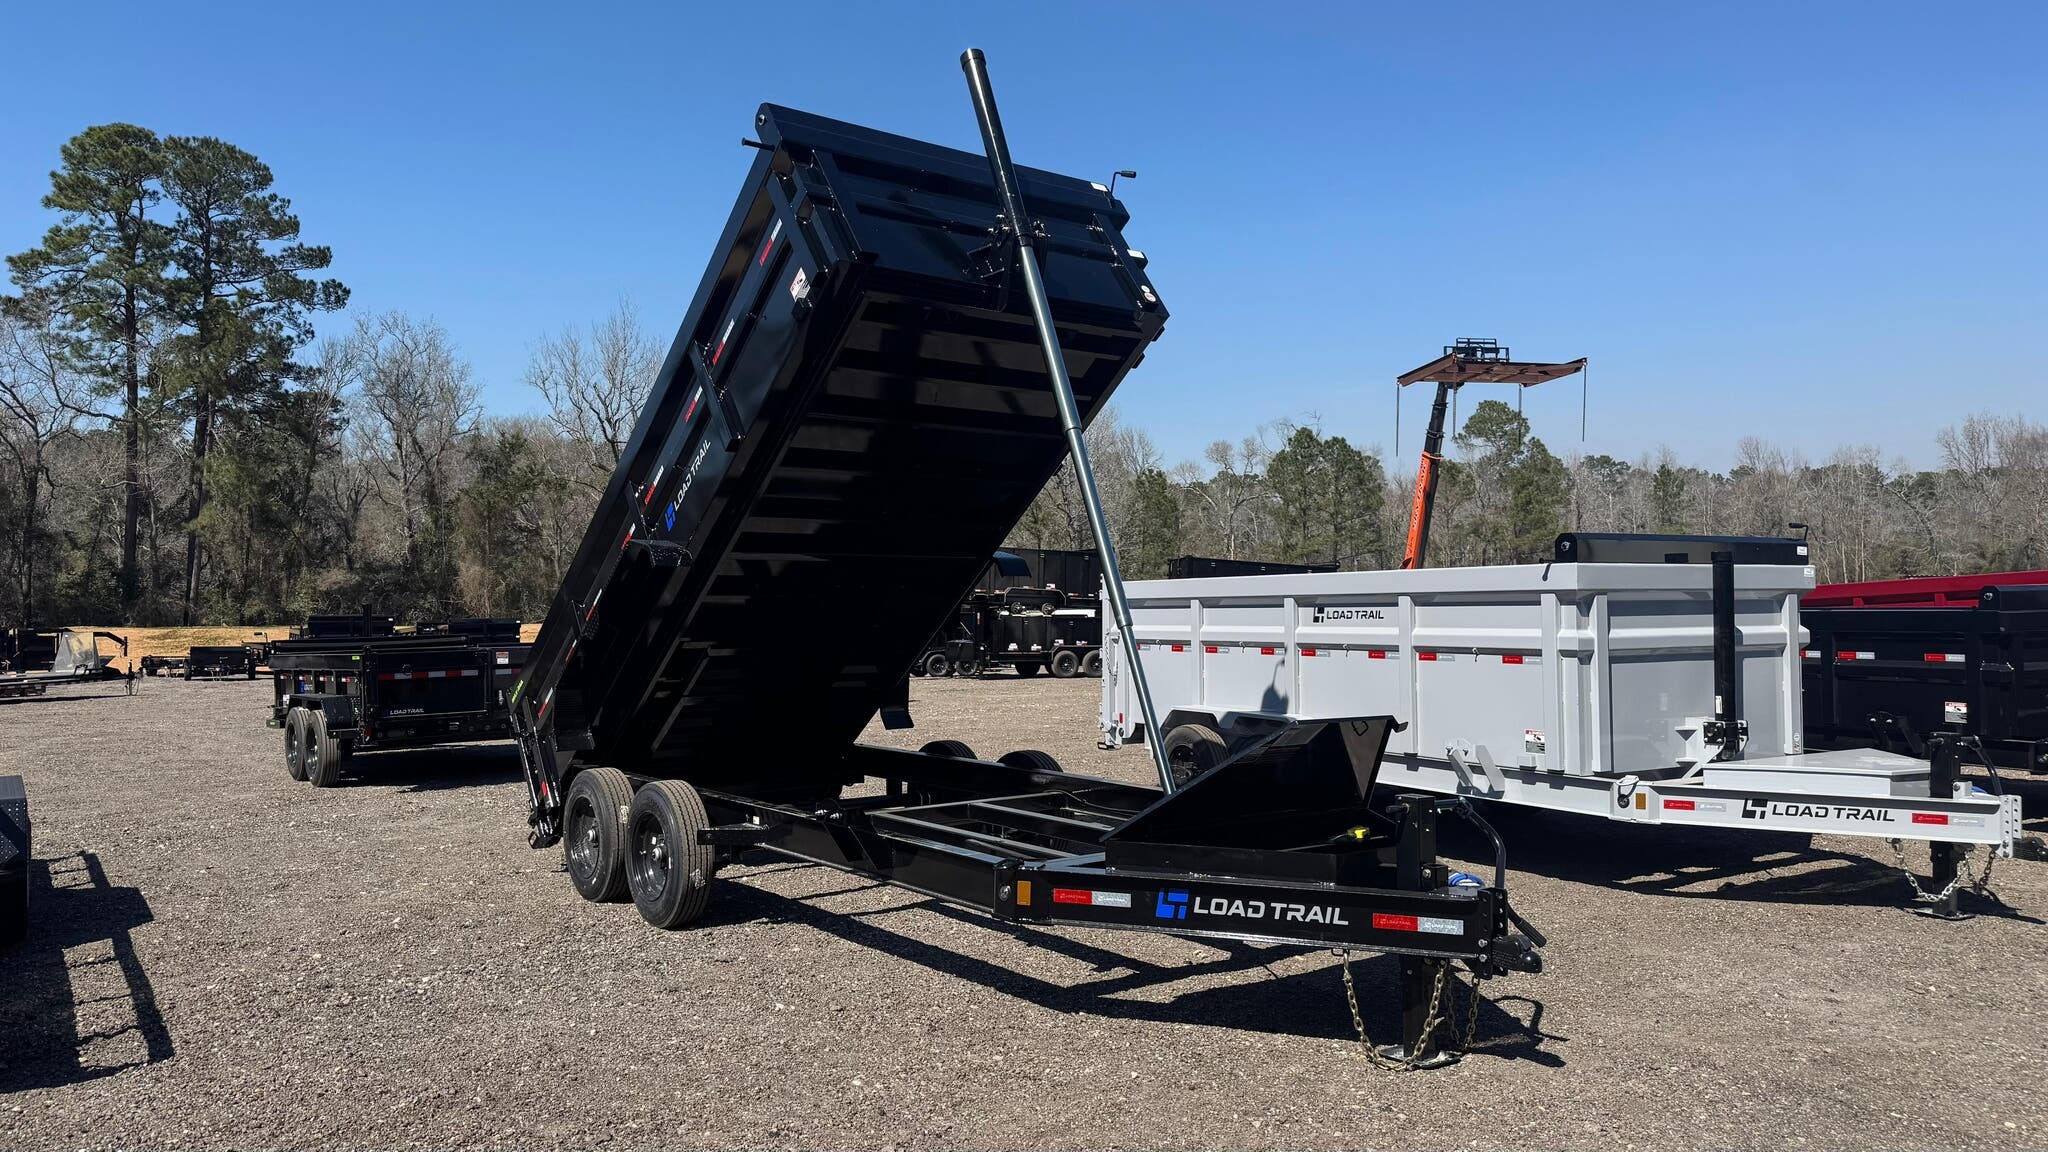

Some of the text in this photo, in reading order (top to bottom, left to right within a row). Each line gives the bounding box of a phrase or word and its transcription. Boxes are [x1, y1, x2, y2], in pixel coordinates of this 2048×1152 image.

[673, 440, 711, 511] LOAD TRAIL
[1326, 610, 1385, 620] LOAD TRAIL
[1771, 803, 1895, 822] LOAD TRAIL
[1193, 896, 1349, 926] LOAD TRAIL
